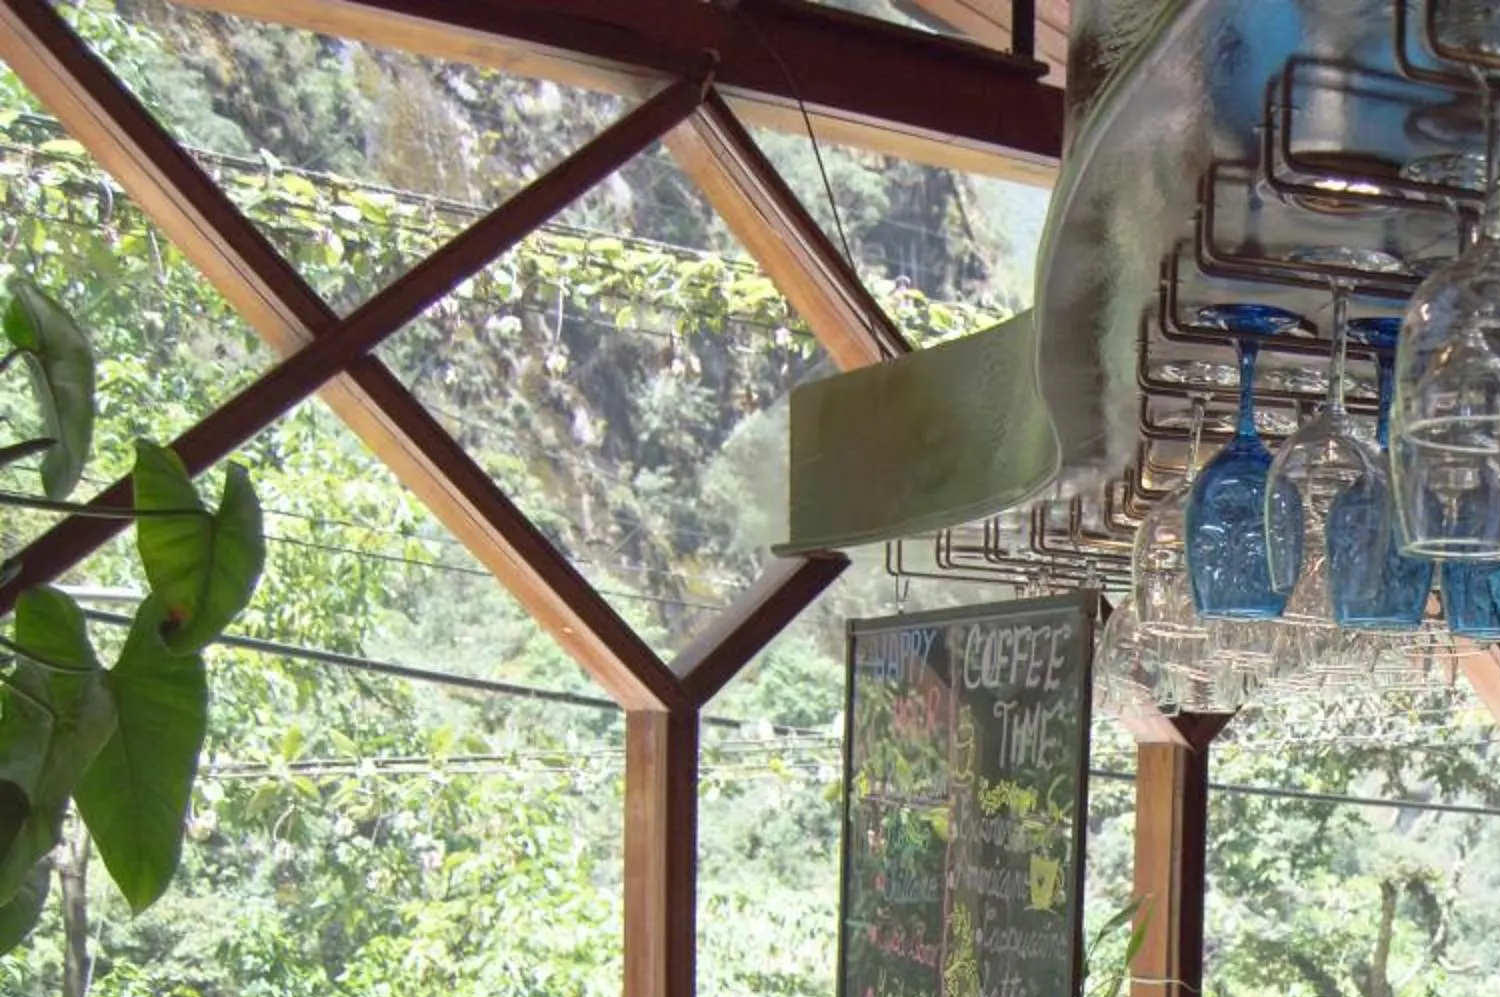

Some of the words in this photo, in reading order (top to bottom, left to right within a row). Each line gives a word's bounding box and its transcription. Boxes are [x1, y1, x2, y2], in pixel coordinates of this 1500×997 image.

[874, 628, 937, 688] HAPPY
[962, 622, 1073, 694] COFFEE
[992, 700, 1068, 772] TIME
